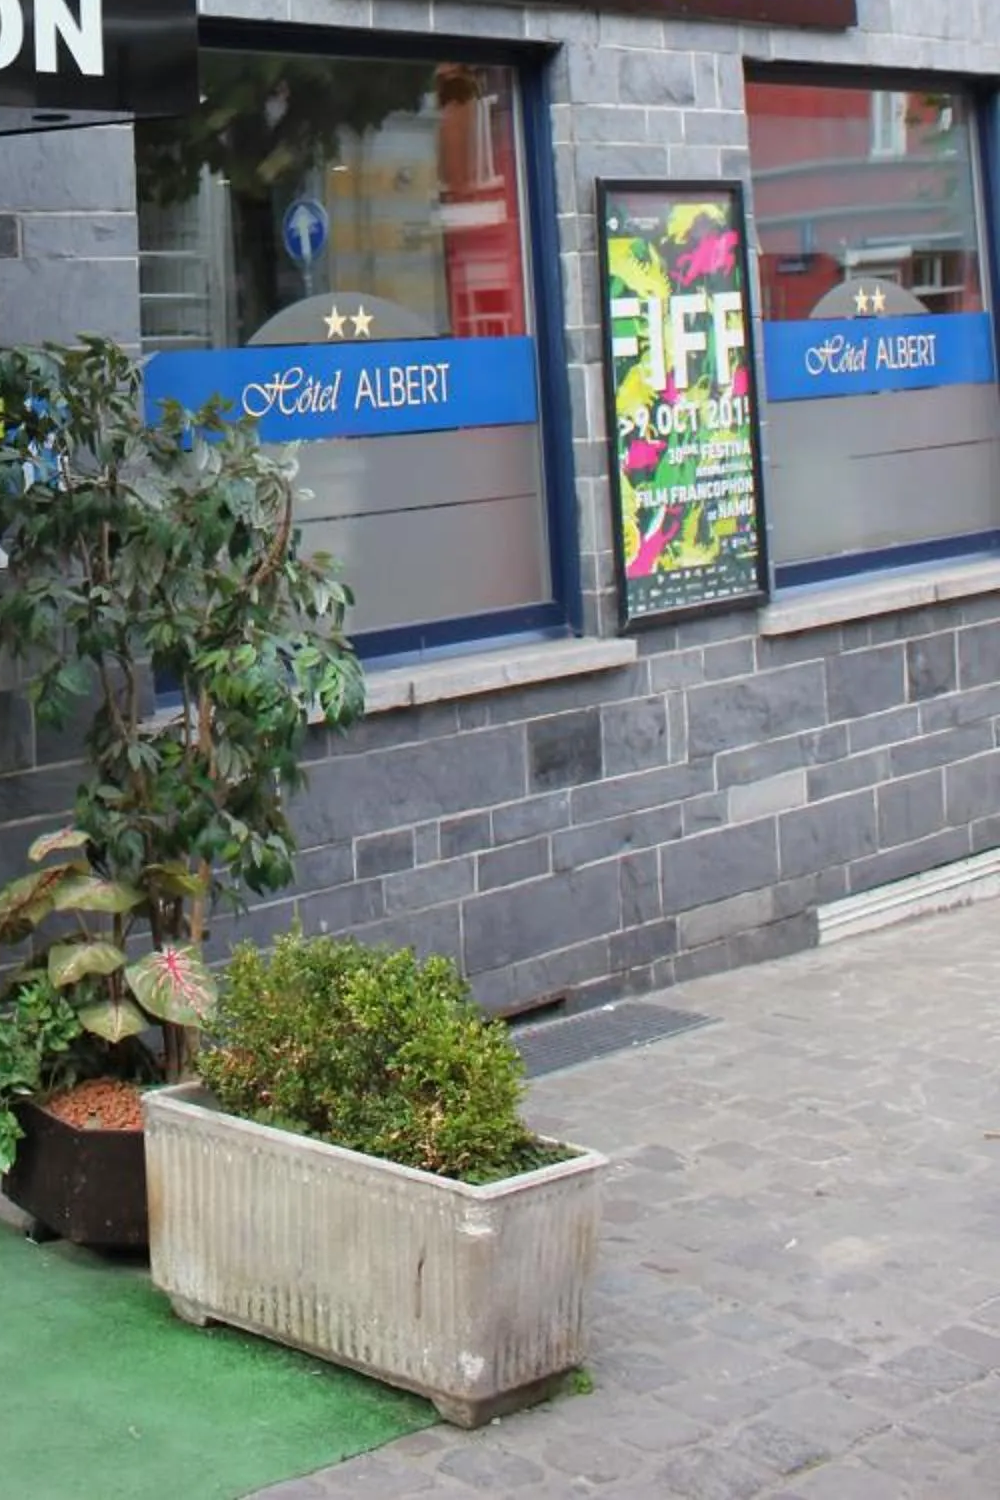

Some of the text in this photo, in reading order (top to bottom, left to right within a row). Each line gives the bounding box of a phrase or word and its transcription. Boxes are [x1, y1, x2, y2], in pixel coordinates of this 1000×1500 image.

[875, 334, 936, 371] ALBERT
[242, 362, 450, 417] Hôtel ALBERT
[656, 399, 698, 435] OCT
